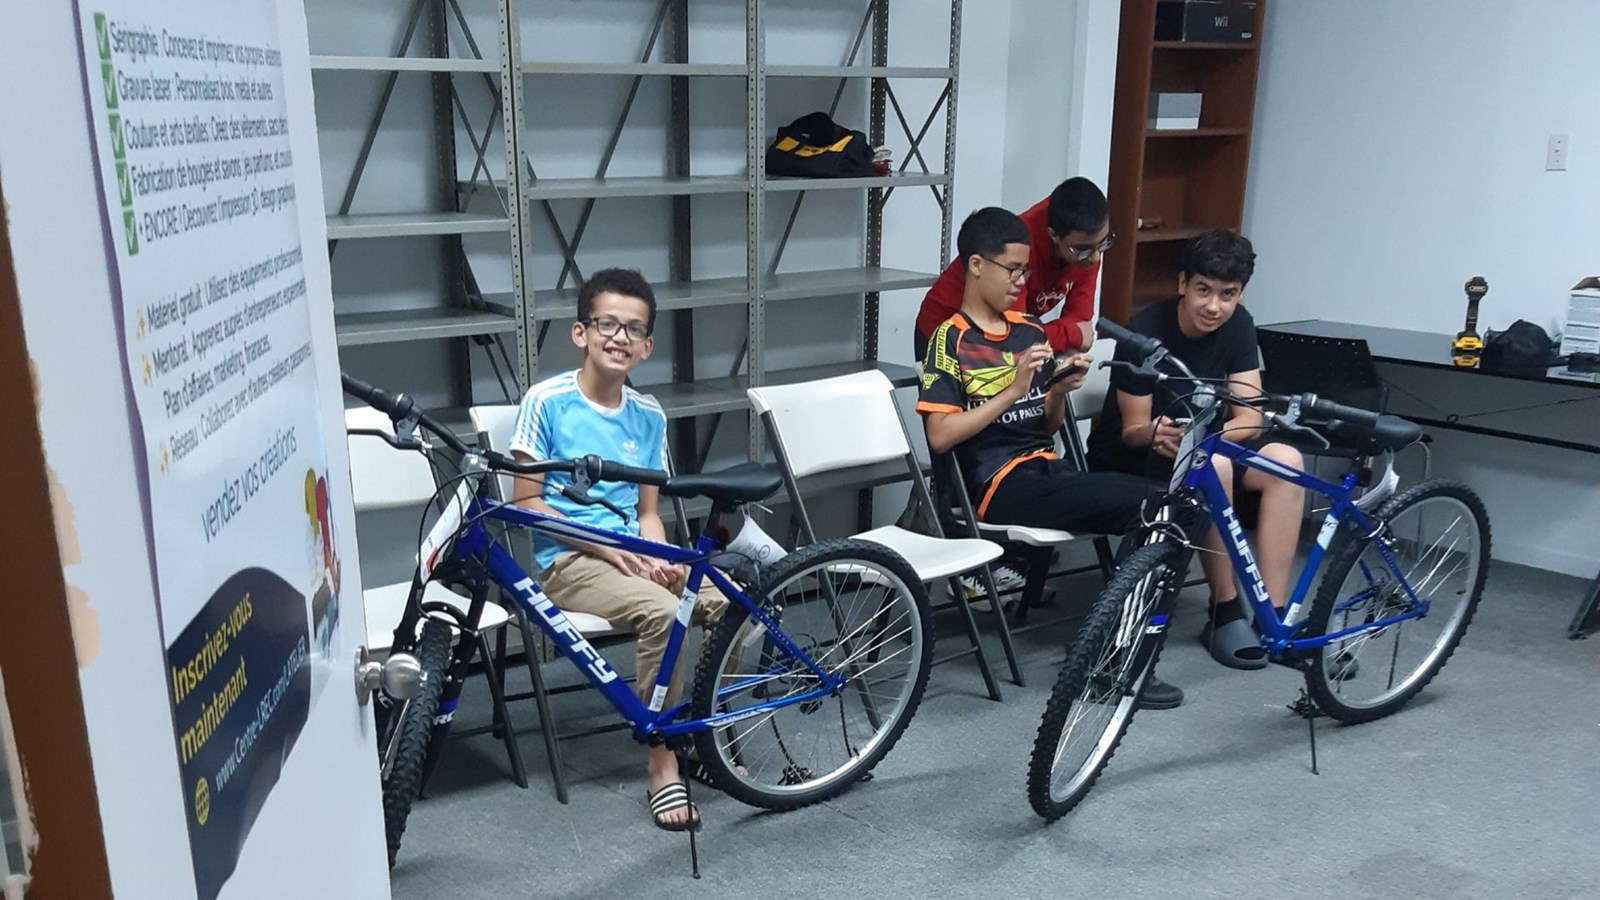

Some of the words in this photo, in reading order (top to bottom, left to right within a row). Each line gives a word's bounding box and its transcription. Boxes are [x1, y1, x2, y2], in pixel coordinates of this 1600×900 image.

[1214, 16, 1229, 27] Wii
[117, 70, 151, 101] Gravure
[151, 71, 171, 100] laser
[125, 119, 160, 150] Couture
[160, 118, 169, 147] et
[169, 117, 184, 146] arts
[131, 161, 177, 196] Fabrication
[177, 160, 187, 187] de
[187, 156, 215, 192] bougies
[144, 206, 179, 242] ENCORE
[147, 292, 179, 334] Matériel
[152, 335, 189, 378] Mentorat
[163, 386, 183, 420] Plan
[1002, 410, 1018, 424] OF
[170, 430, 199, 463] Réseau
[200, 402, 235, 440] Collaborez
[202, 479, 242, 543] vendez
[241, 461, 260, 502] vos
[259, 426, 297, 485] créations
[1222, 506, 1270, 602] HUFFY
[172, 592, 253, 704] Inscrivez-vous
[514, 577, 618, 684] HUFFY
[180, 654, 248, 765] maintenant
